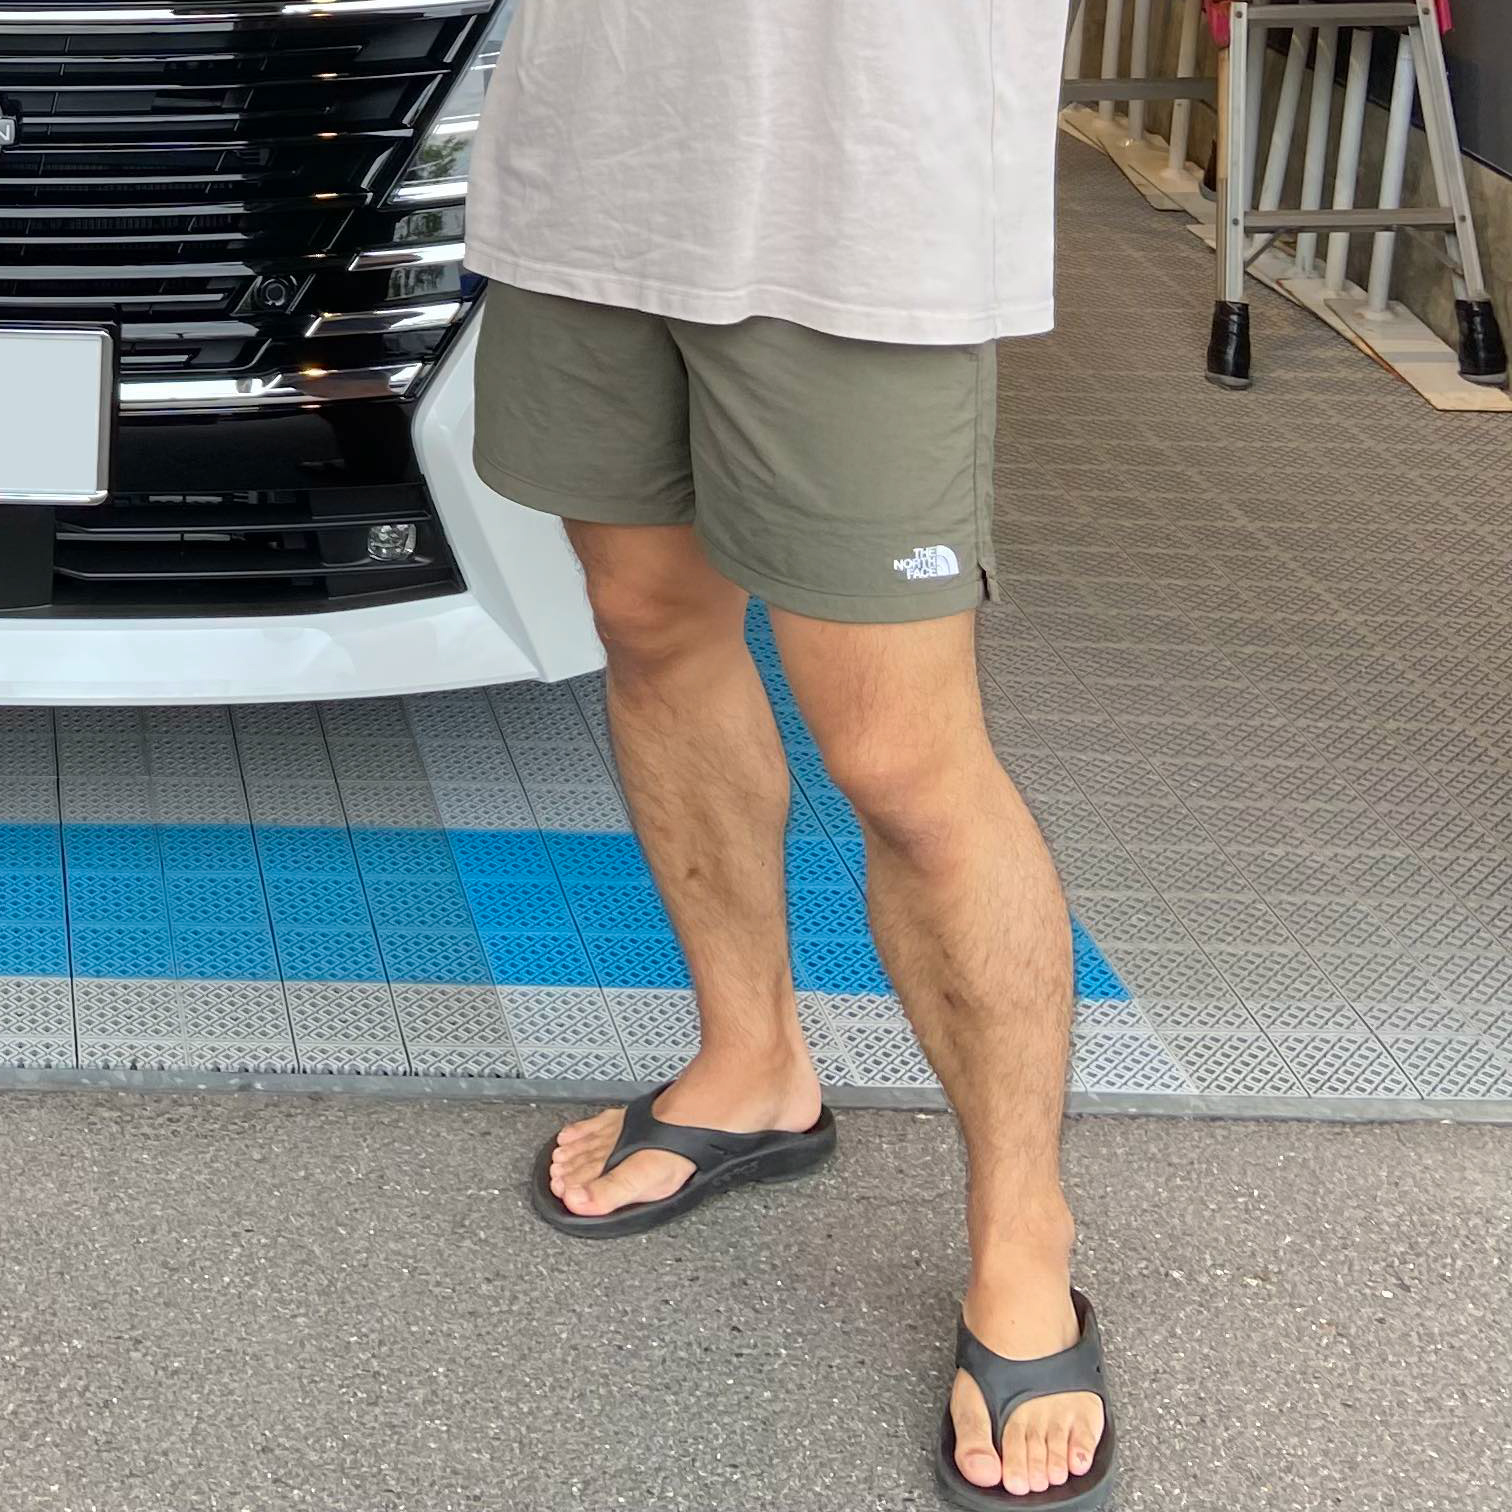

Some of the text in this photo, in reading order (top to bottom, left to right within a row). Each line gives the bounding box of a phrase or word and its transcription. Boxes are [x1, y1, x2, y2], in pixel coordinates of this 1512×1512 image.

[913, 547, 937, 558] THE
[893, 558, 937, 571] NORTH
[907, 568, 937, 580] FACE
